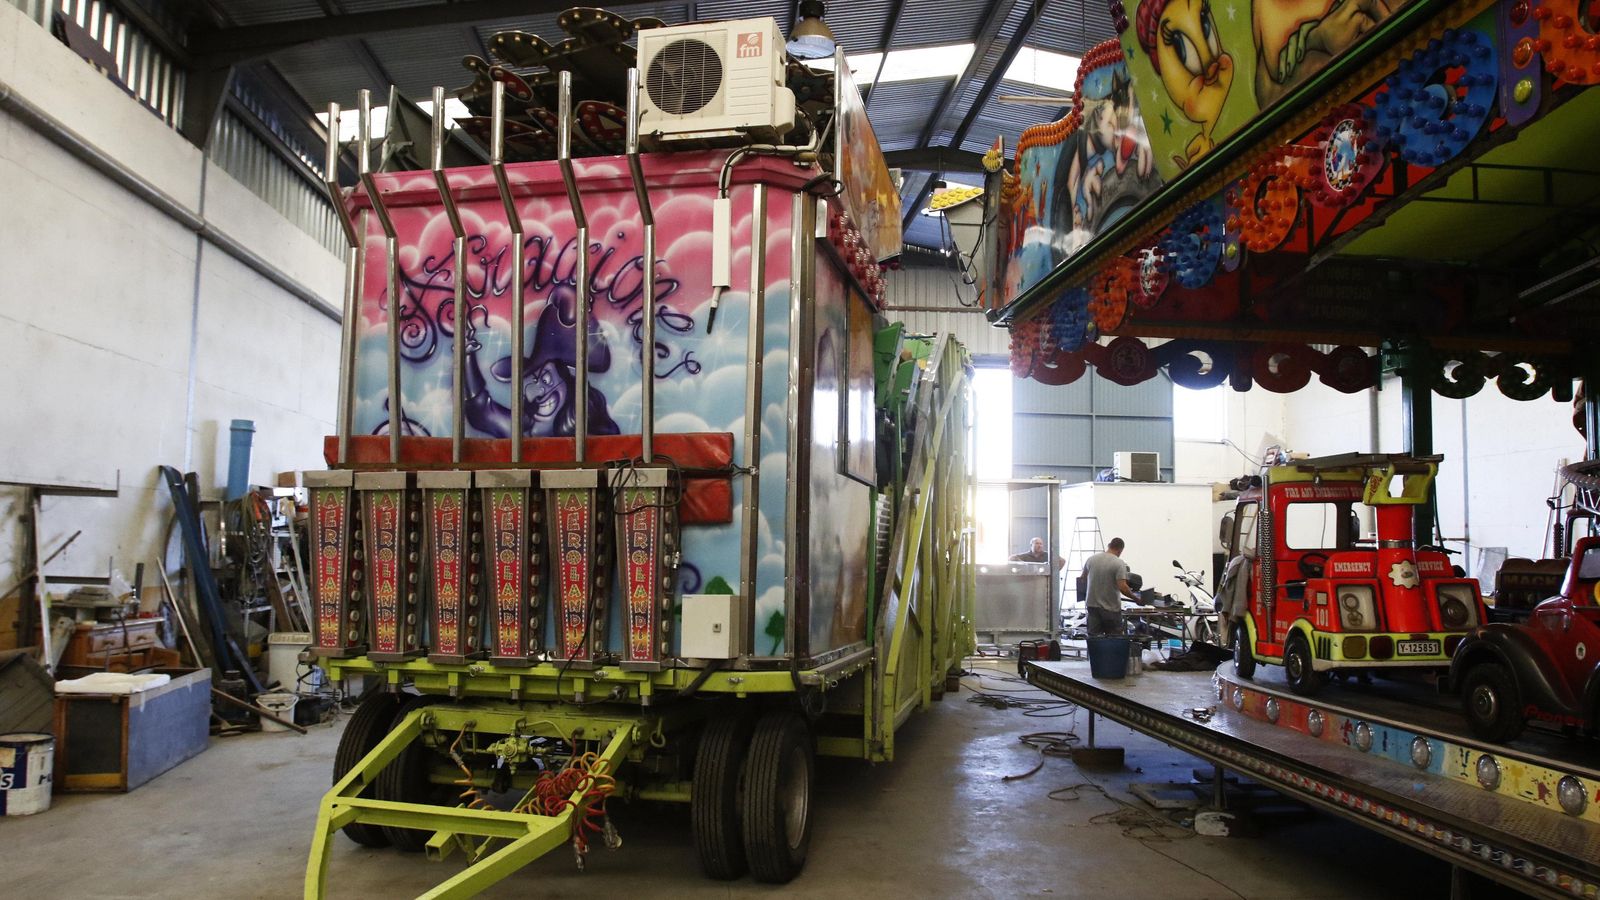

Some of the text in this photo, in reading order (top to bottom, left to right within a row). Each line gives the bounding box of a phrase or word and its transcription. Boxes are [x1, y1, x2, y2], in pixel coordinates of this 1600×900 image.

[740, 44, 760, 57] fm
[1333, 561, 1371, 573] EMERGENCY
[1316, 608, 1329, 627] 101
[1400, 643, 1438, 653] Y-125851
